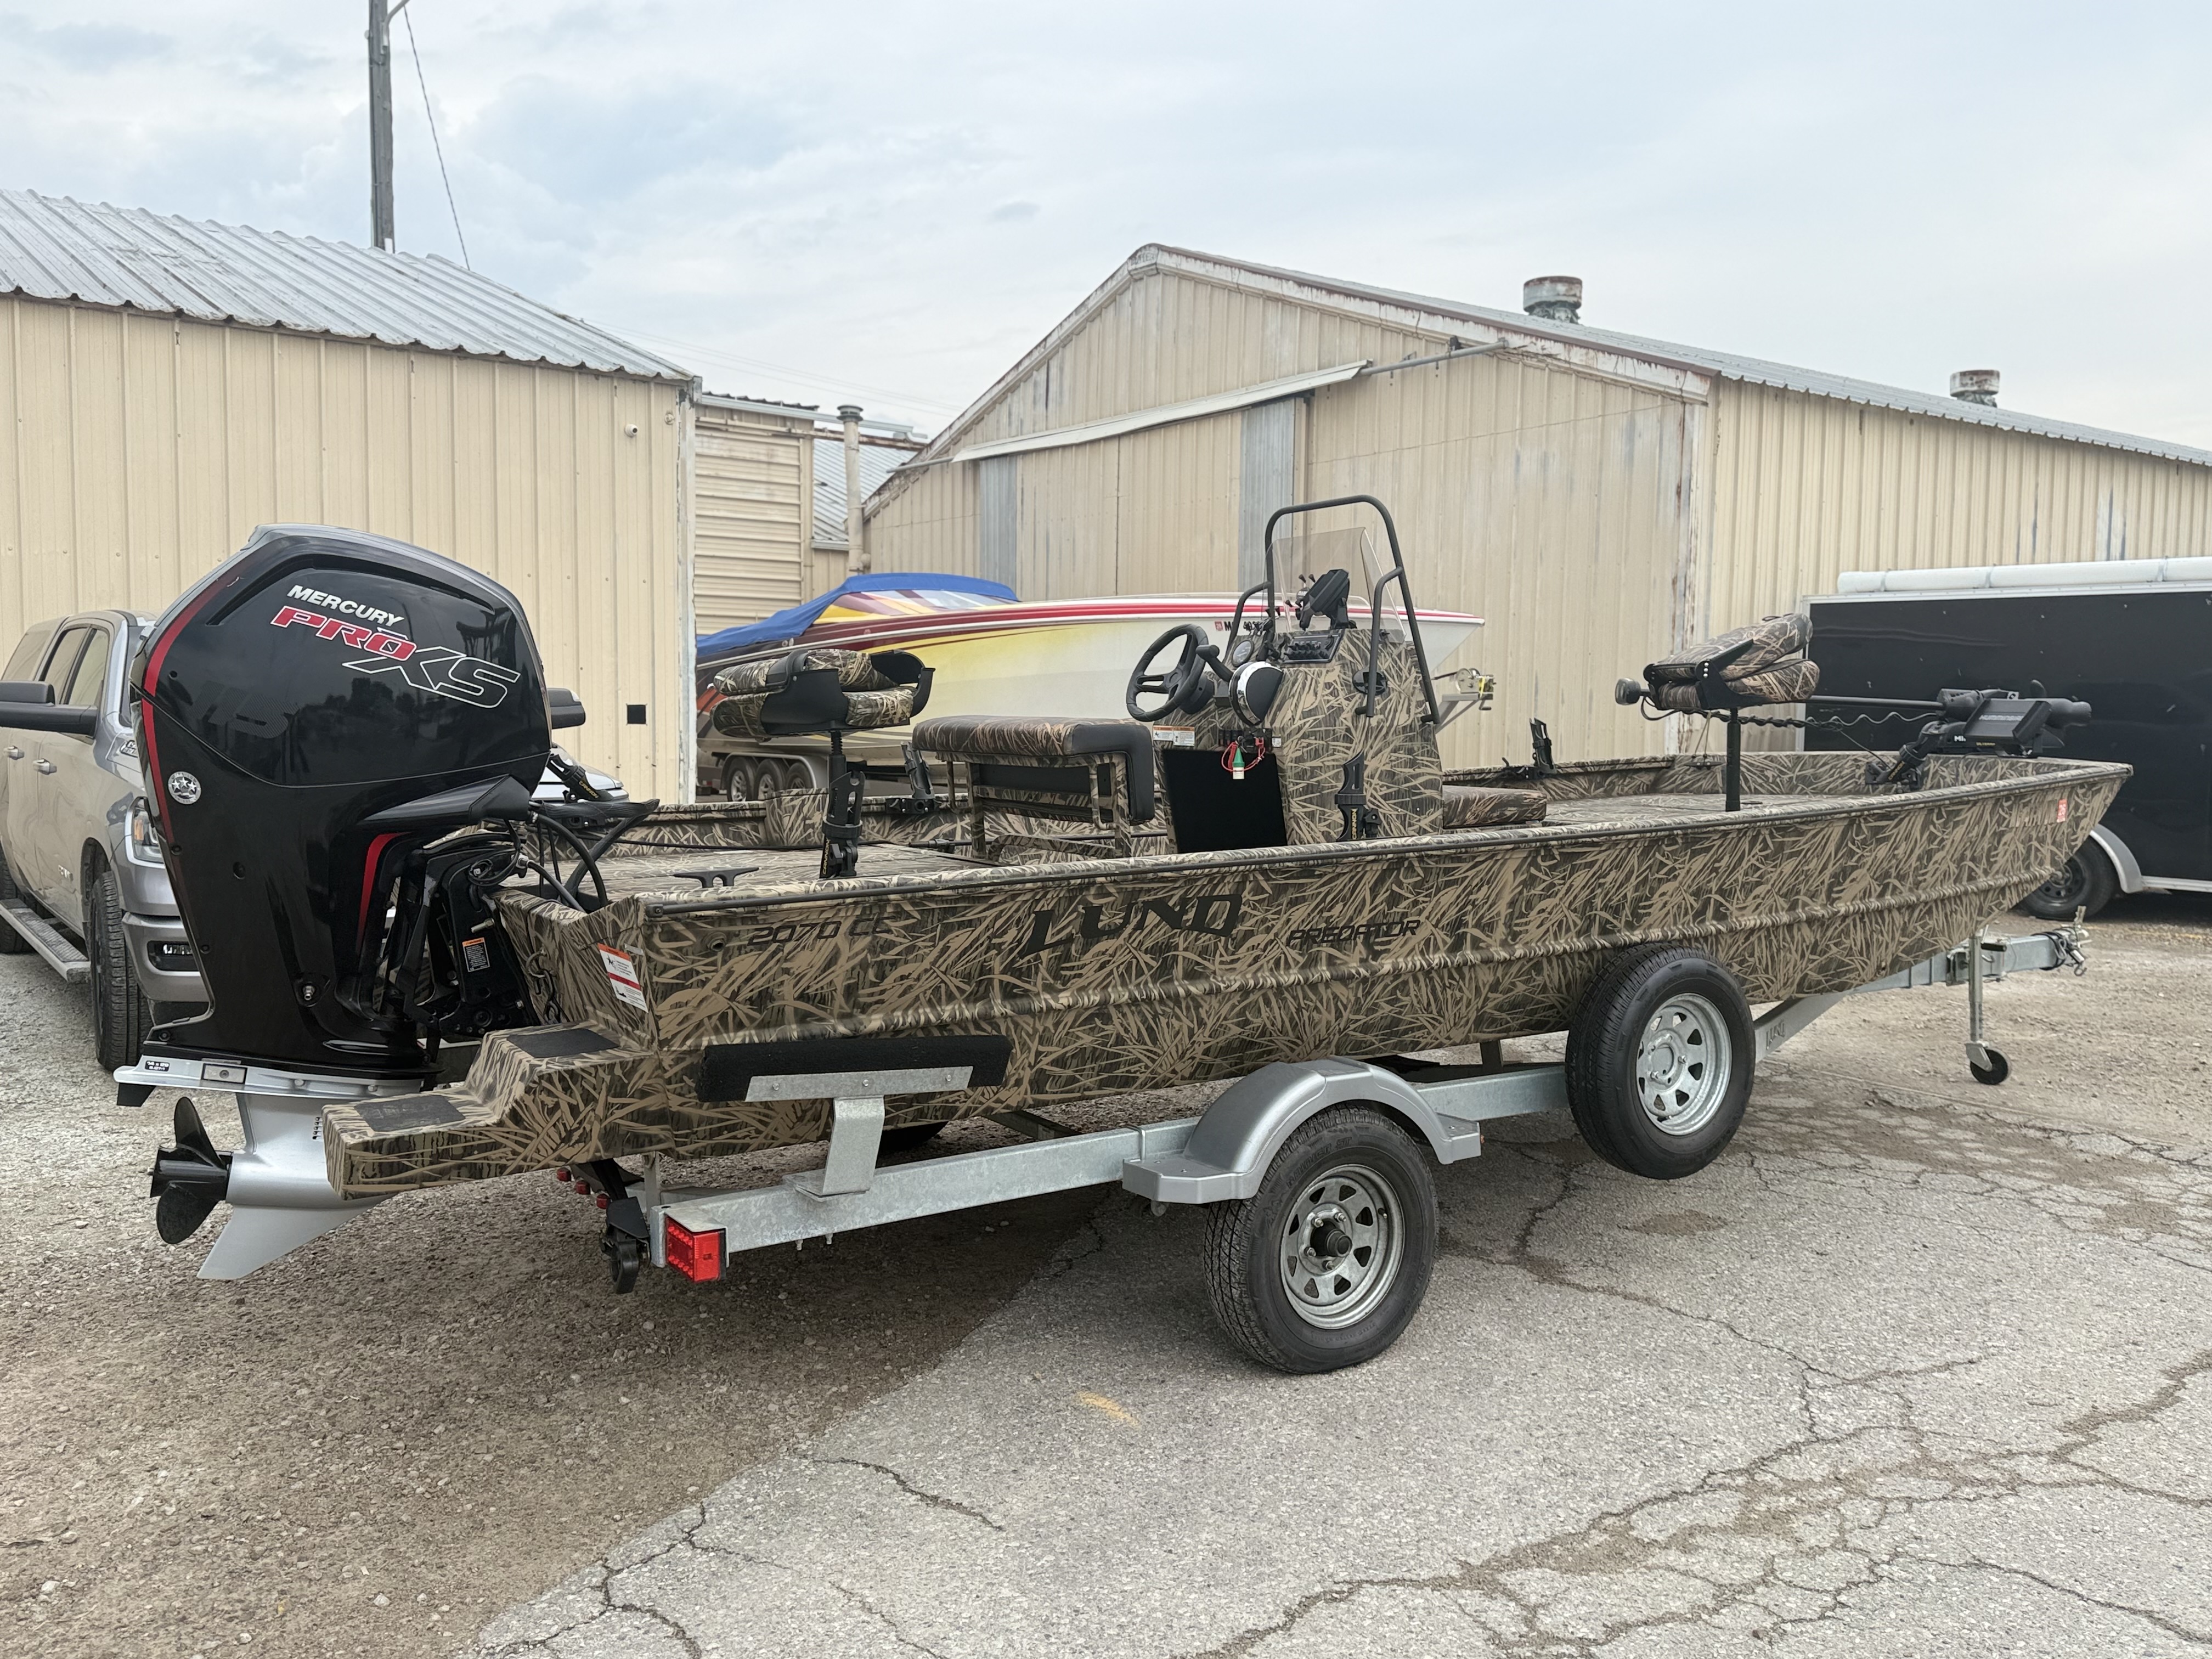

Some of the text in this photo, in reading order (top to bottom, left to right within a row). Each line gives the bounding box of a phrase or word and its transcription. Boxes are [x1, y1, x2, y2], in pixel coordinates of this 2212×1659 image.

[287, 585, 404, 627] MERCURY
[270, 605, 521, 708] PRO XS
[185, 680, 300, 739] 115
[579, 780, 599, 798] CANNON
[822, 837, 831, 875] CANNON
[747, 921, 842, 946] 2070
[1019, 894, 1242, 958] LUND
[1287, 919, 1421, 947] PREDATOR
